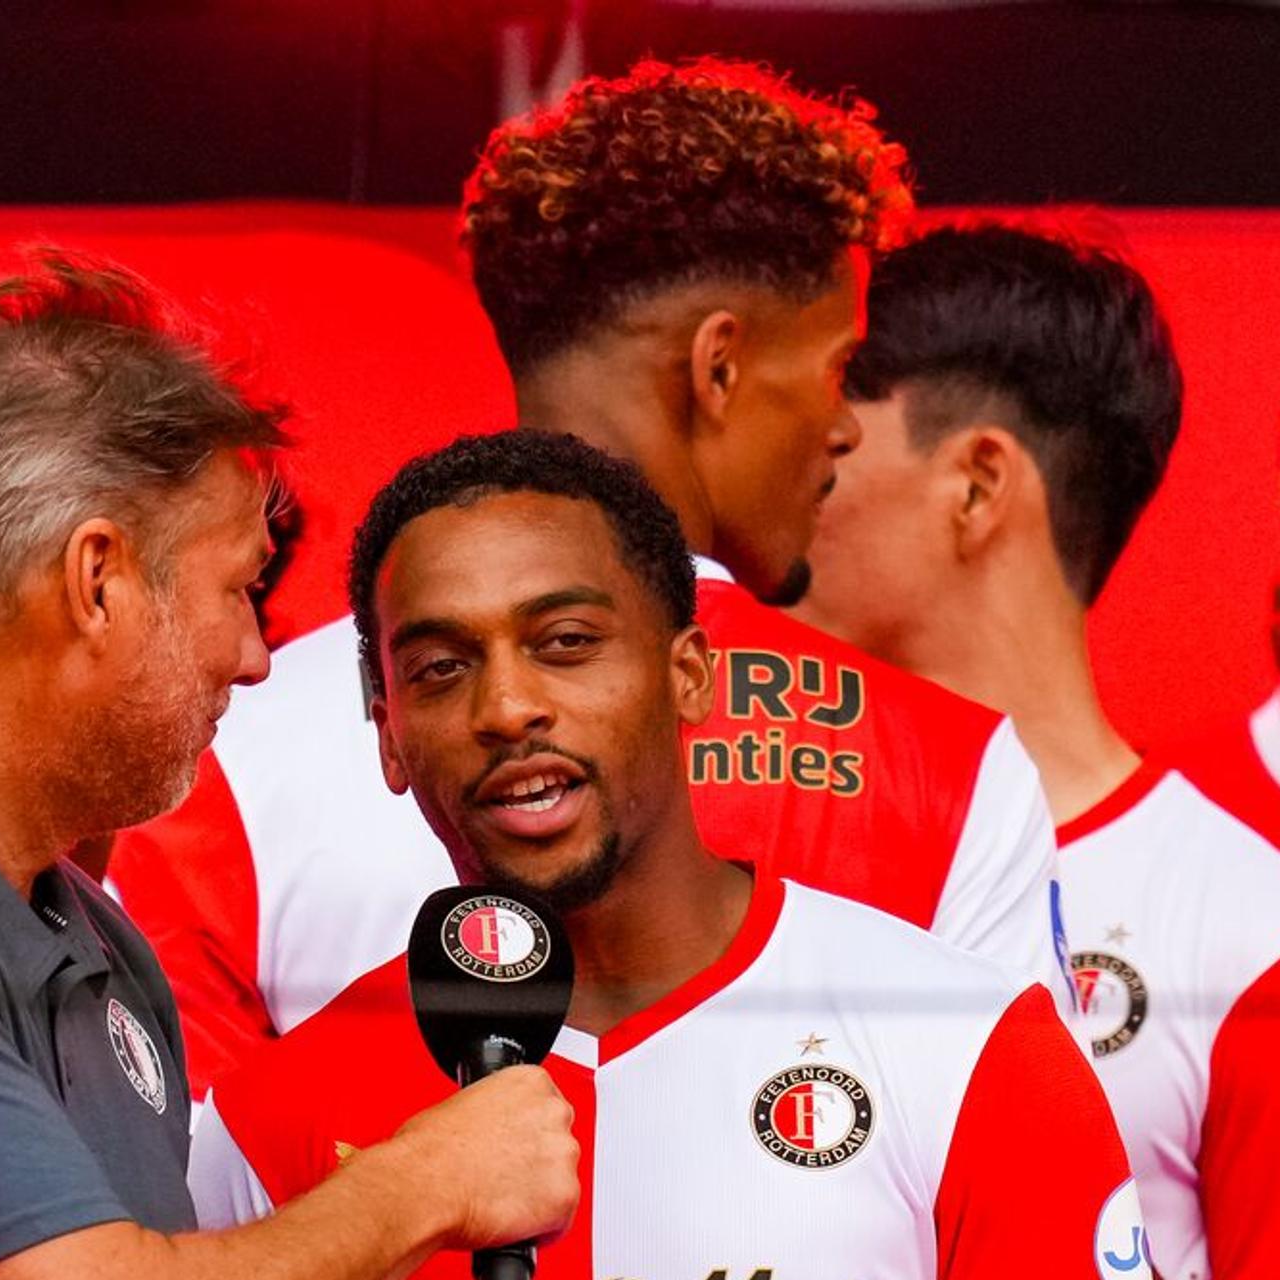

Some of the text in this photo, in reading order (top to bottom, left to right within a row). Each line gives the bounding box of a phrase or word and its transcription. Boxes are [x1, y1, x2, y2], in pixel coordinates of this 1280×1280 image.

[709, 650, 864, 730] RIJ
[690, 729, 864, 797] nties
[449, 897, 541, 930] FEYENOORD
[452, 947, 544, 977] ROTTERDAM
[759, 1068, 865, 1103] FEYENOORD
[759, 1127, 869, 1167] ROTTERDAM
